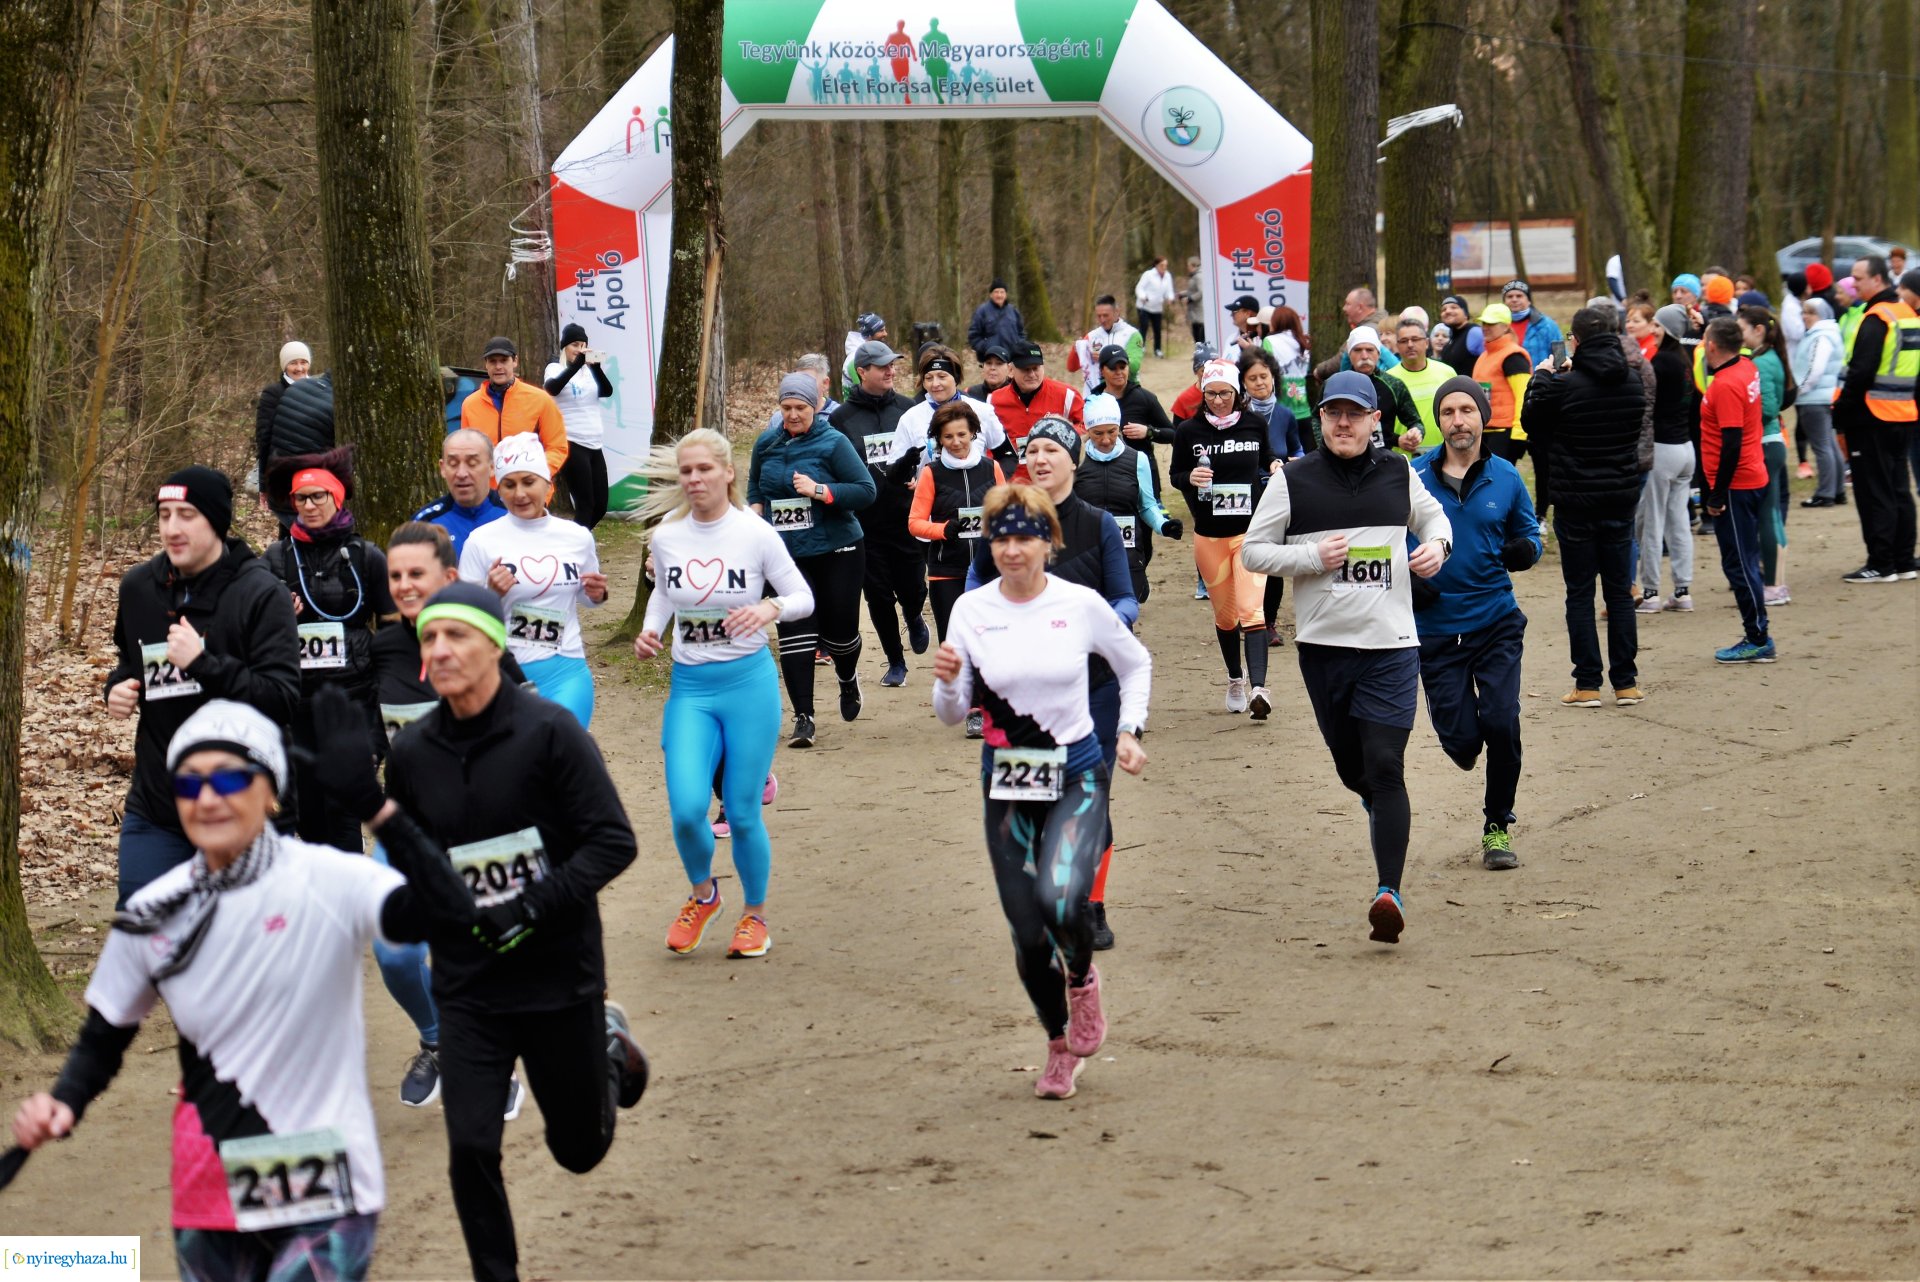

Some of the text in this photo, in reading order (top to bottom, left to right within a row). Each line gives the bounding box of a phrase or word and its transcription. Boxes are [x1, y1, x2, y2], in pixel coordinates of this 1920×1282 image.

[739, 39, 821, 62] Tegyünk
[829, 40, 911, 59] Közösen
[919, 36, 1089, 62] Magyarországért
[822, 74, 1035, 97] Élet Forása Egyesület
[1231, 249, 1255, 292] Fitt
[1255, 209, 1287, 307] ondozó
[575, 269, 596, 312] Fitt
[597, 250, 630, 331] Ápoló
[1214, 493, 1248, 509] 217
[773, 507, 805, 525] 228
[960, 516, 982, 532] 22
[1342, 560, 1382, 582] 160
[511, 615, 560, 642] 215
[681, 618, 728, 641] 214
[300, 635, 339, 658] 201
[997, 761, 1052, 788] 224
[462, 853, 533, 895] 204
[233, 1156, 330, 1208] 212
